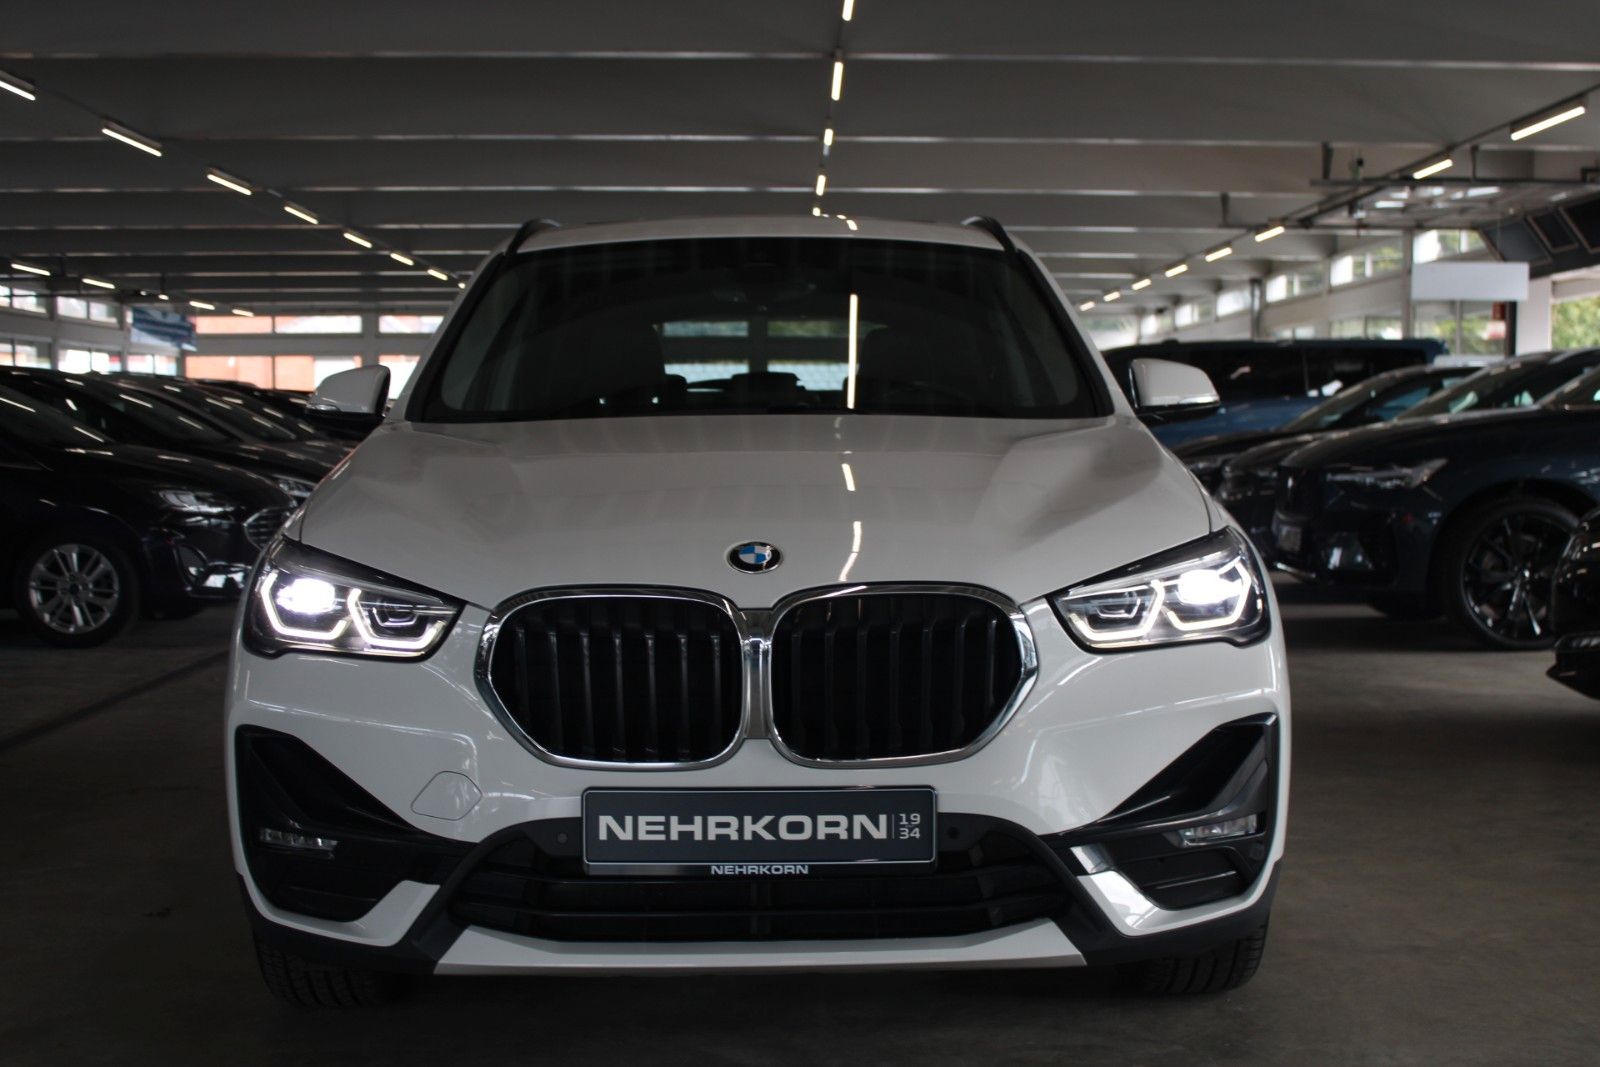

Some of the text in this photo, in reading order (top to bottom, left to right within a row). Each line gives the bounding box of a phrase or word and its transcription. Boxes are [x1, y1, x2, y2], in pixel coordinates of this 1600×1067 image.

[899, 813, 921, 825] 19
[598, 814, 888, 841] NEHRKORN
[899, 827, 921, 840] 34
[711, 864, 810, 876] NEHRKORN
